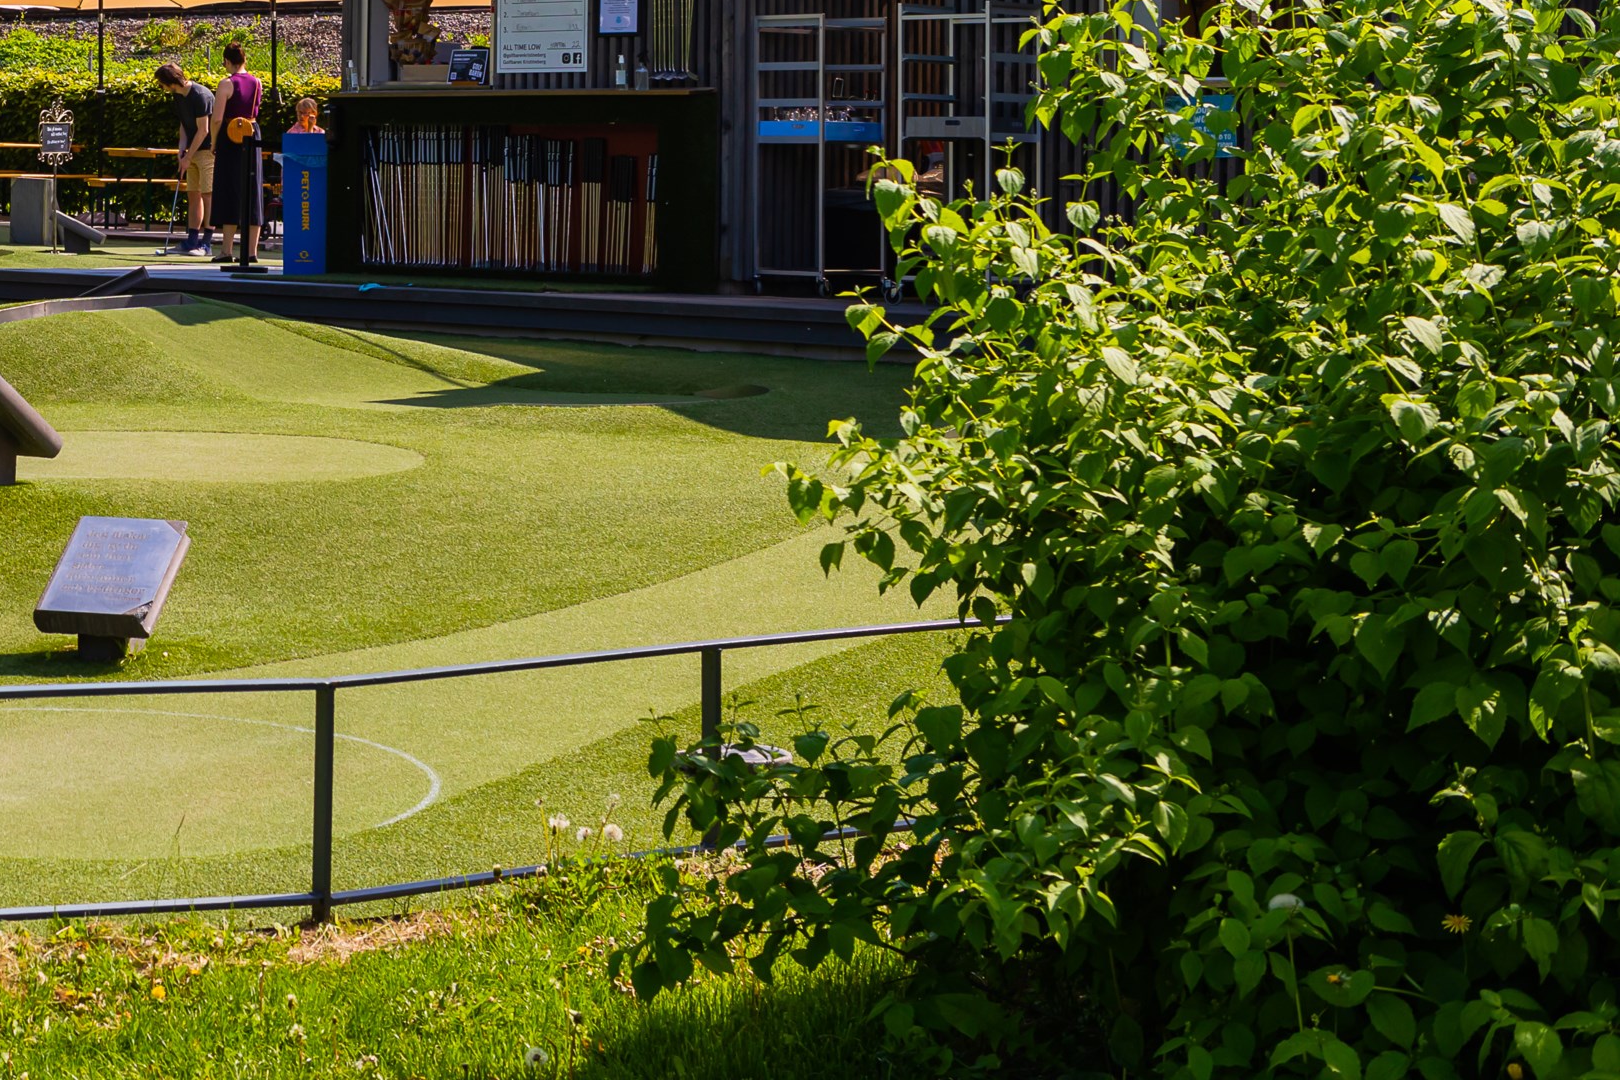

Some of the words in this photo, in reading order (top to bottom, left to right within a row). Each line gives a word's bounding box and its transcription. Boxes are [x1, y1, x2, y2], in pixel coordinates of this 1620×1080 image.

[528, 43, 542, 51] LOW
[301, 170, 310, 191] PET
[301, 201, 310, 231] BURK
